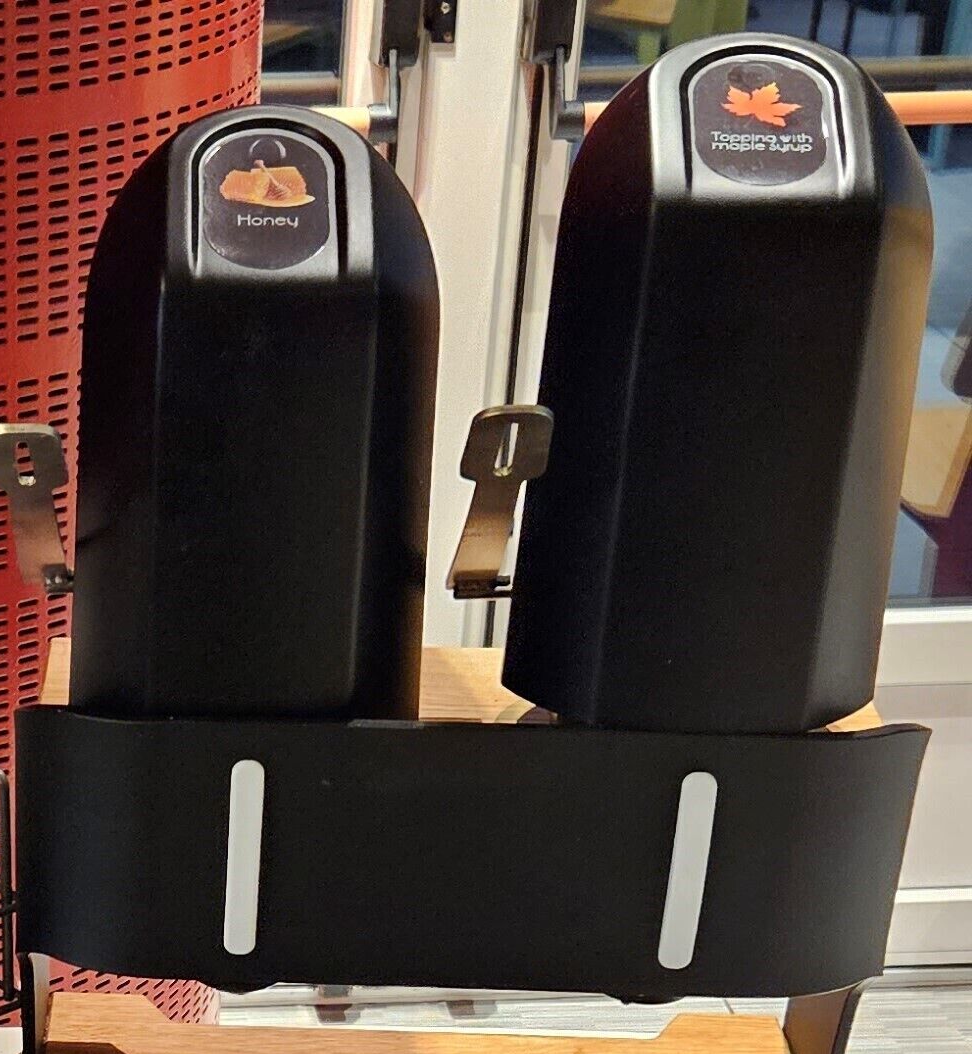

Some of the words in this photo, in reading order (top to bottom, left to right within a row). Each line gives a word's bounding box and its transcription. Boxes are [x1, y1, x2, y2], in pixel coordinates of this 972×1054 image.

[711, 131, 777, 143] Topping
[779, 132, 813, 143] with
[711, 141, 766, 153] maple
[769, 141, 813, 153] syrup
[237, 214, 299, 229] Honey
